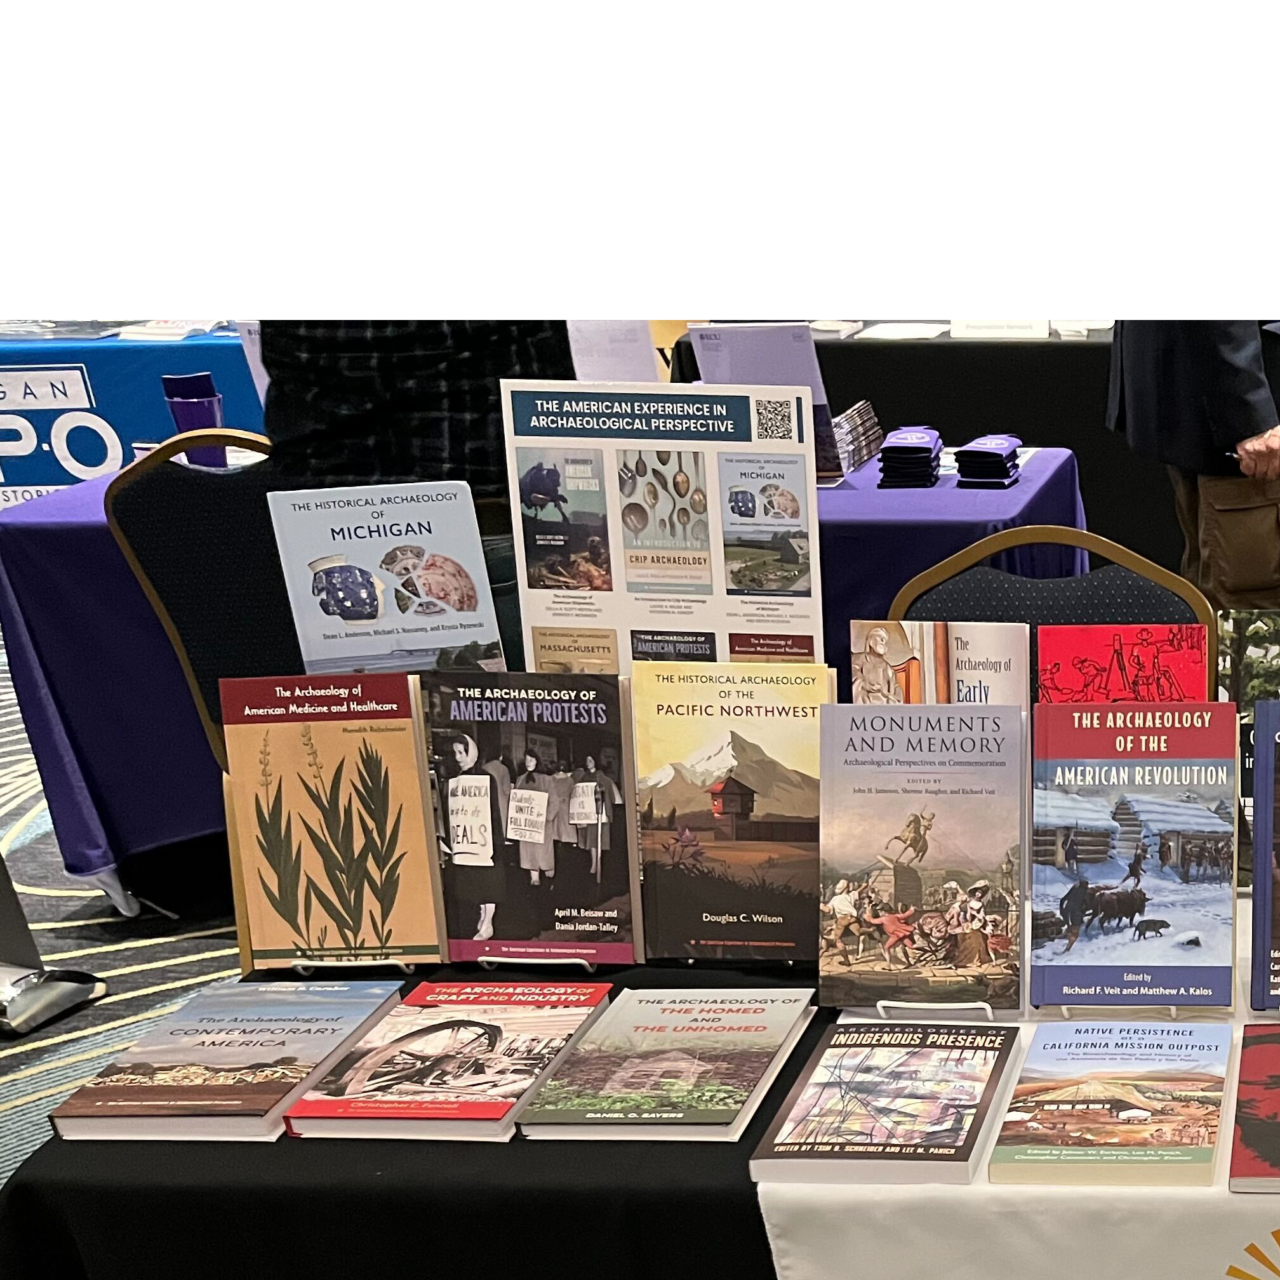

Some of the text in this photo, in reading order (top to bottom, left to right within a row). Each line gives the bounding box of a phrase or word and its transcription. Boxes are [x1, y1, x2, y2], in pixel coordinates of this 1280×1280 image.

[535, 400, 726, 416] THE AMERICAN EXPERIENCE IN
[530, 416, 734, 432] ARCHAEOLOGICAL PERSPECTIVE
[739, 471, 785, 480] MICHIGAN
[291, 492, 458, 512] THE HISTORICAL ARCHAEOLOGY
[371, 510, 385, 519] OF
[330, 521, 433, 541] MICHIGAN
[629, 555, 707, 566] CRIP ARCHAEOLOGY
[539, 644, 612, 654] MASSACHUSETTS
[637, 643, 710, 655] AMERICAN PROTESTS
[955, 637, 969, 651] The
[955, 658, 1011, 673] Archaeology of
[655, 674, 817, 685] THE HISTORICAL ARCHAEOLOGY
[274, 684, 361, 698] The Archaeology of
[457, 687, 596, 701] THE ARCHAEOLOGY OF
[737, 691, 754, 699] THE
[956, 680, 990, 703] Early
[244, 700, 398, 716] American Medicine and Healthcare
[450, 700, 607, 724] AMERICAN PROTESTS
[657, 704, 818, 718] PACIFIC NORTHWEST
[850, 716, 1001, 733] MONUMENTS
[1073, 711, 1212, 728] THE ARCHAEOLOGY
[845, 736, 1006, 753] AND MEMORY
[1115, 736, 1168, 752] OF THE
[1055, 766, 1227, 786] AMERICAN REVOLUTION
[703, 913, 783, 924] Douglas C. Wilson
[169, 1028, 344, 1036] CONTEMPORARY
[1119, 1028, 1195, 1037] PERSISTENCE
[191, 1040, 287, 1048] AMERICA
[831, 1034, 1005, 1048] INDIGENOUS PRESENCE
[1043, 1041, 1109, 1050] CALIFORNIA
[1114, 1042, 1163, 1050] MISSION
